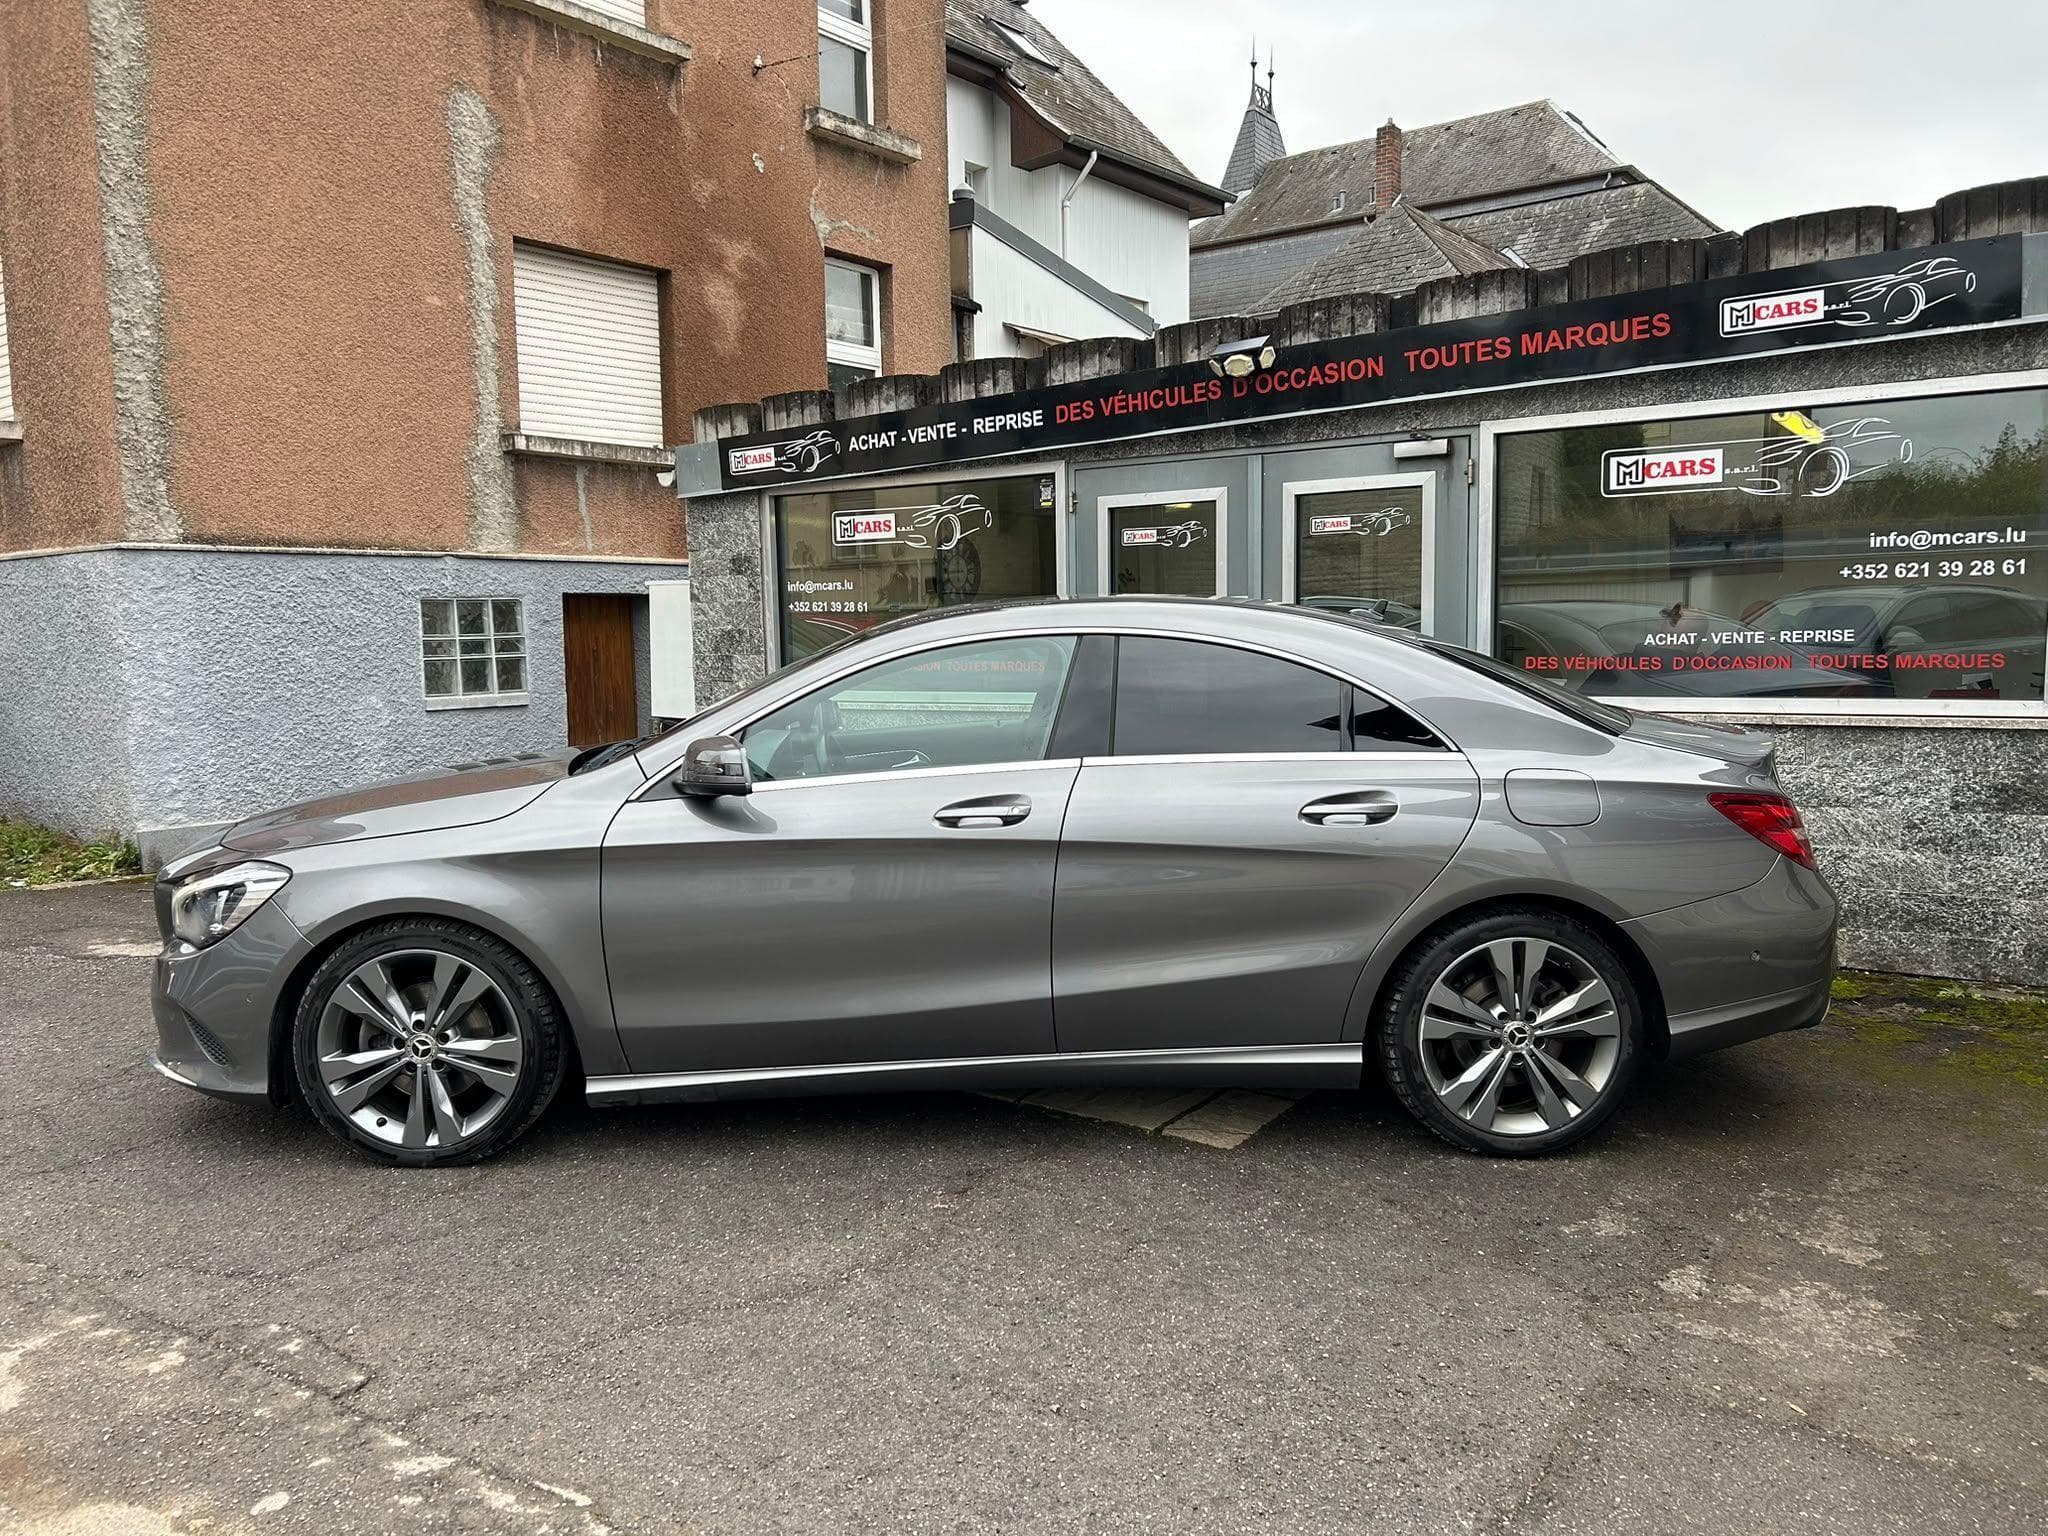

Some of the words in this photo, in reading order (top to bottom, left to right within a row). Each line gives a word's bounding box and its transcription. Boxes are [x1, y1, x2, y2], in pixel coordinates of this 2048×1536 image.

[849, 431, 897, 451] ACHAT
[973, 410, 1043, 434] REPRISE
[1055, 400, 1094, 424] DES
[1100, 379, 1221, 417] VÉHICULES
[1233, 355, 1384, 398] D'OCCASION
[1404, 336, 1511, 372] TOUTES
[1521, 313, 1671, 356] MARQUES
[1724, 464, 1758, 474] s.a.r.l.
[1869, 527, 2026, 550] info@mcars.lu
[1839, 563, 1888, 580] +352
[1894, 562, 1930, 578] 621
[1938, 561, 1963, 577] 39
[1969, 560, 1995, 576] 28
[2002, 558, 2026, 575] 61
[787, 579, 853, 593] info@mcars.lu
[788, 601, 810, 612] +352
[812, 601, 828, 612] 621
[830, 601, 842, 612] 39
[843, 601, 855, 612] 28
[857, 601, 868, 612] 61
[1643, 632, 1697, 646] ACHAT
[1711, 631, 1765, 644] VENTE
[1780, 629, 1855, 643] REPRISE
[1525, 656, 1558, 670] DES
[1563, 653, 1662, 670] VÉHICULES
[1672, 655, 1792, 670] D'OCCASION
[1808, 654, 1889, 669] TOUTES
[1895, 653, 2006, 670] MARQUES
